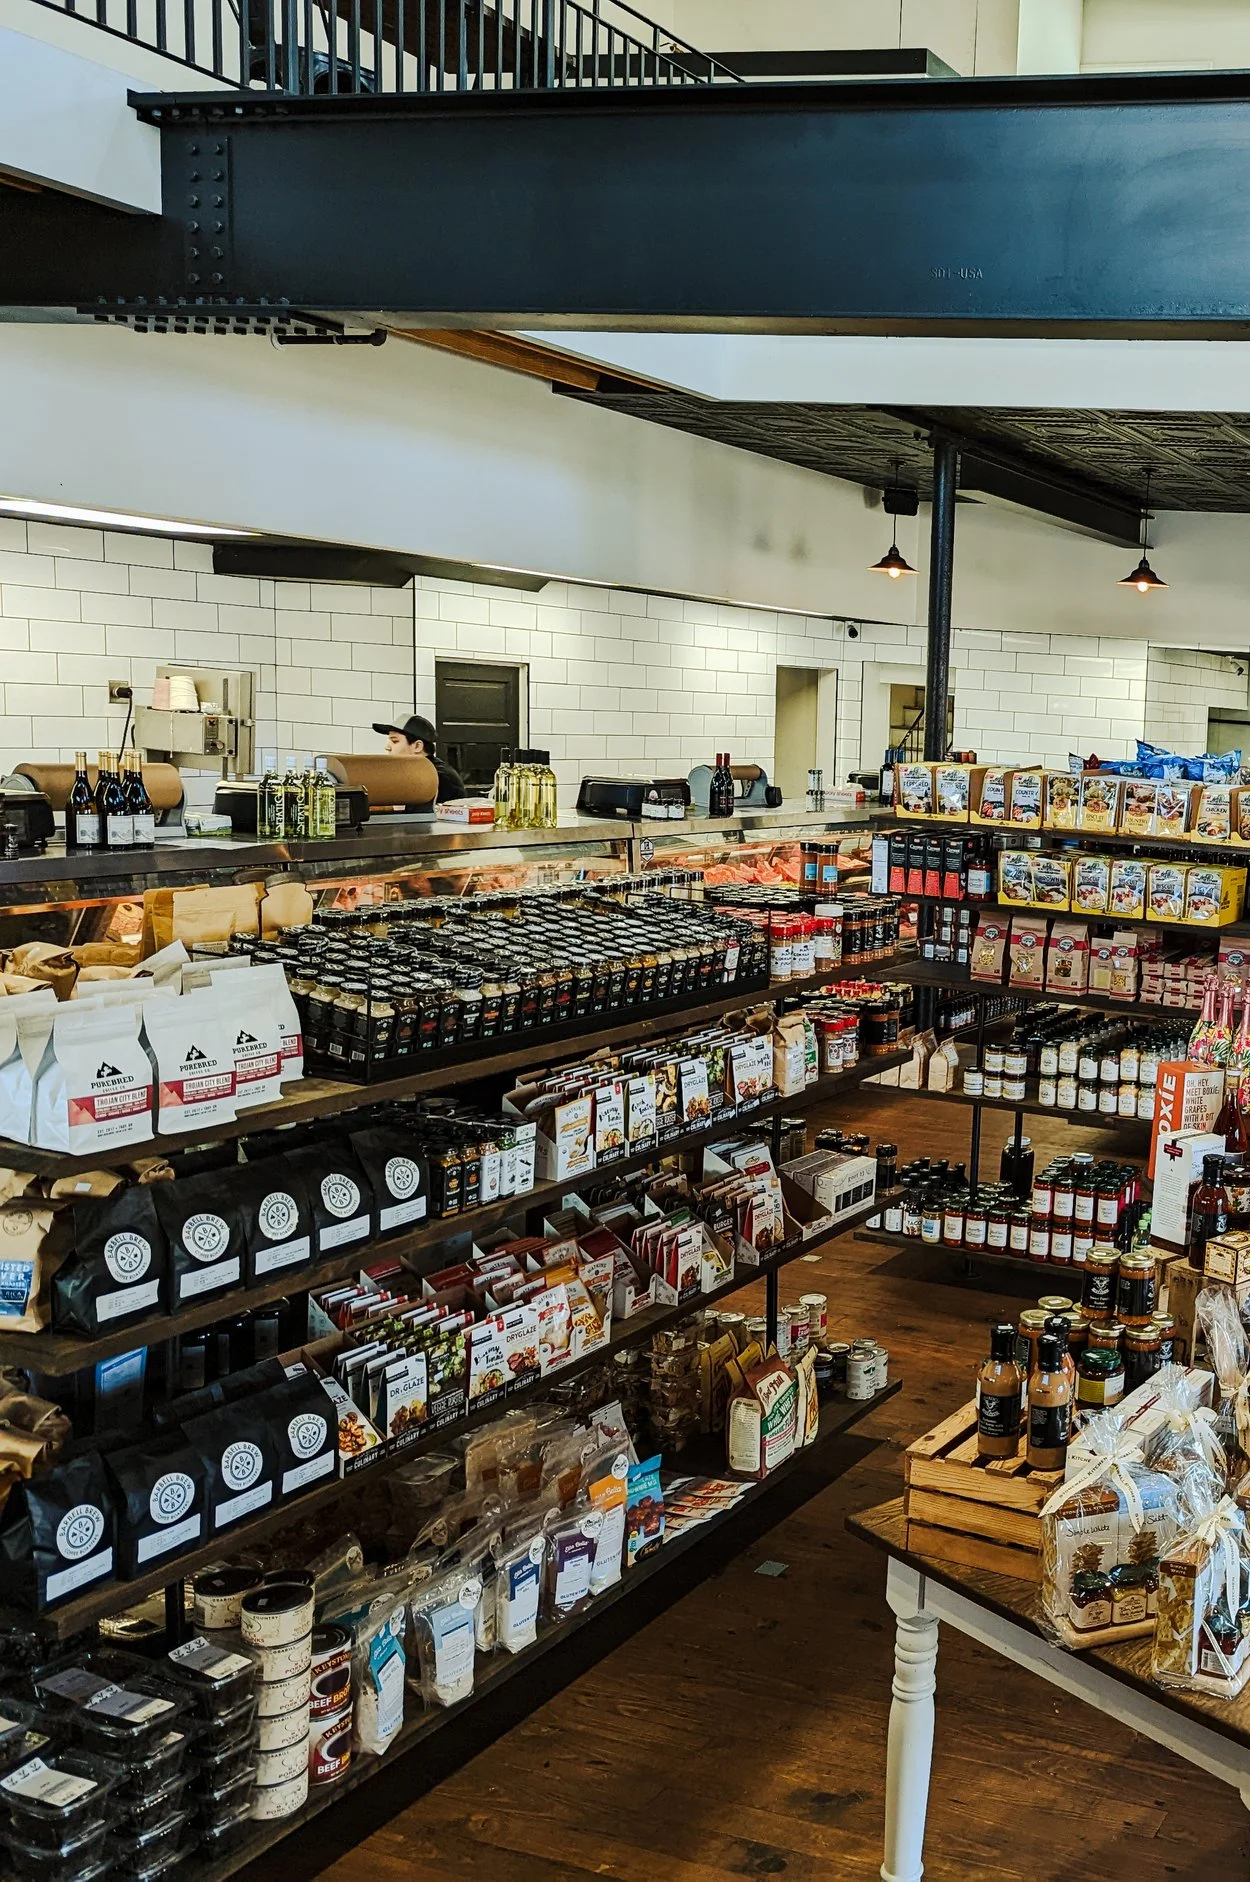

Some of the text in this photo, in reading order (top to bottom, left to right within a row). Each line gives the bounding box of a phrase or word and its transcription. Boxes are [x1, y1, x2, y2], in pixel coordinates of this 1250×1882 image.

[232, 1042, 268, 1054] PUREBRED
[282, 1038, 296, 1046] BLEND
[180, 1060, 218, 1072] PUREBRED
[238, 1056, 276, 1071] TROJAN CITY BLEND
[735, 1060, 756, 1072] DRYGLAZE
[91, 1076, 134, 1089] PUREBRED
[186, 1076, 230, 1090] TROJAN CITY BLEND
[684, 1077, 706, 1088] DRYGLAZE
[97, 1091, 146, 1106] TROJAN CITY BLEND
[1186, 1088, 1201, 1096] MEET
[1158, 1073, 1176, 1135] OXÍE
[1186, 1096, 1203, 1104] WHITE
[1184, 1105, 1208, 1114] GRAPES
[1184, 1114, 1198, 1122] WITH
[1206, 1112, 1214, 1120] BIT
[1192, 1122, 1206, 1130] SKIN
[634, 1141, 651, 1152] CULINARY
[602, 1151, 620, 1161] CULINARY
[388, 1159, 418, 1178] BARBELL BREW
[323, 1176, 355, 1196] BARBELL BREW
[261, 1194, 296, 1217] BARBELL BREW
[185, 1216, 226, 1240] BARBELL BREW
[714, 1218, 734, 1231] BURGER
[108, 1235, 148, 1259] BARBELL BREW
[0, 1263, 30, 1272] ISTED
[0, 1272, 24, 1280] VER
[506, 1326, 537, 1343] DRYGLAZE
[514, 1377, 534, 1390] CULINARY
[772, 1374, 785, 1396] Mill
[292, 1416, 325, 1438] BARBELL BREW
[224, 1444, 260, 1469] BARBELL BREW
[354, 1453, 378, 1469] CULINARY
[1072, 1455, 1092, 1463] KITCHE
[1088, 1456, 1108, 1476] KITCHEN
[152, 1475, 192, 1502] BARBELL BREW
[60, 1507, 102, 1537] BARBELL BREW
[1066, 1525, 1110, 1538] Simple White
[596, 1556, 616, 1566] GLUTEN
[1170, 1568, 1186, 1576] WHITE
[560, 1590, 578, 1600] GLUTEN
[513, 1617, 530, 1628] GLUTEN
[314, 1652, 351, 1674] KEYSTON
[310, 1682, 350, 1709] BEEF BRO
[325, 1716, 352, 1738] KEYST
[317, 1758, 340, 1775] BEEF
